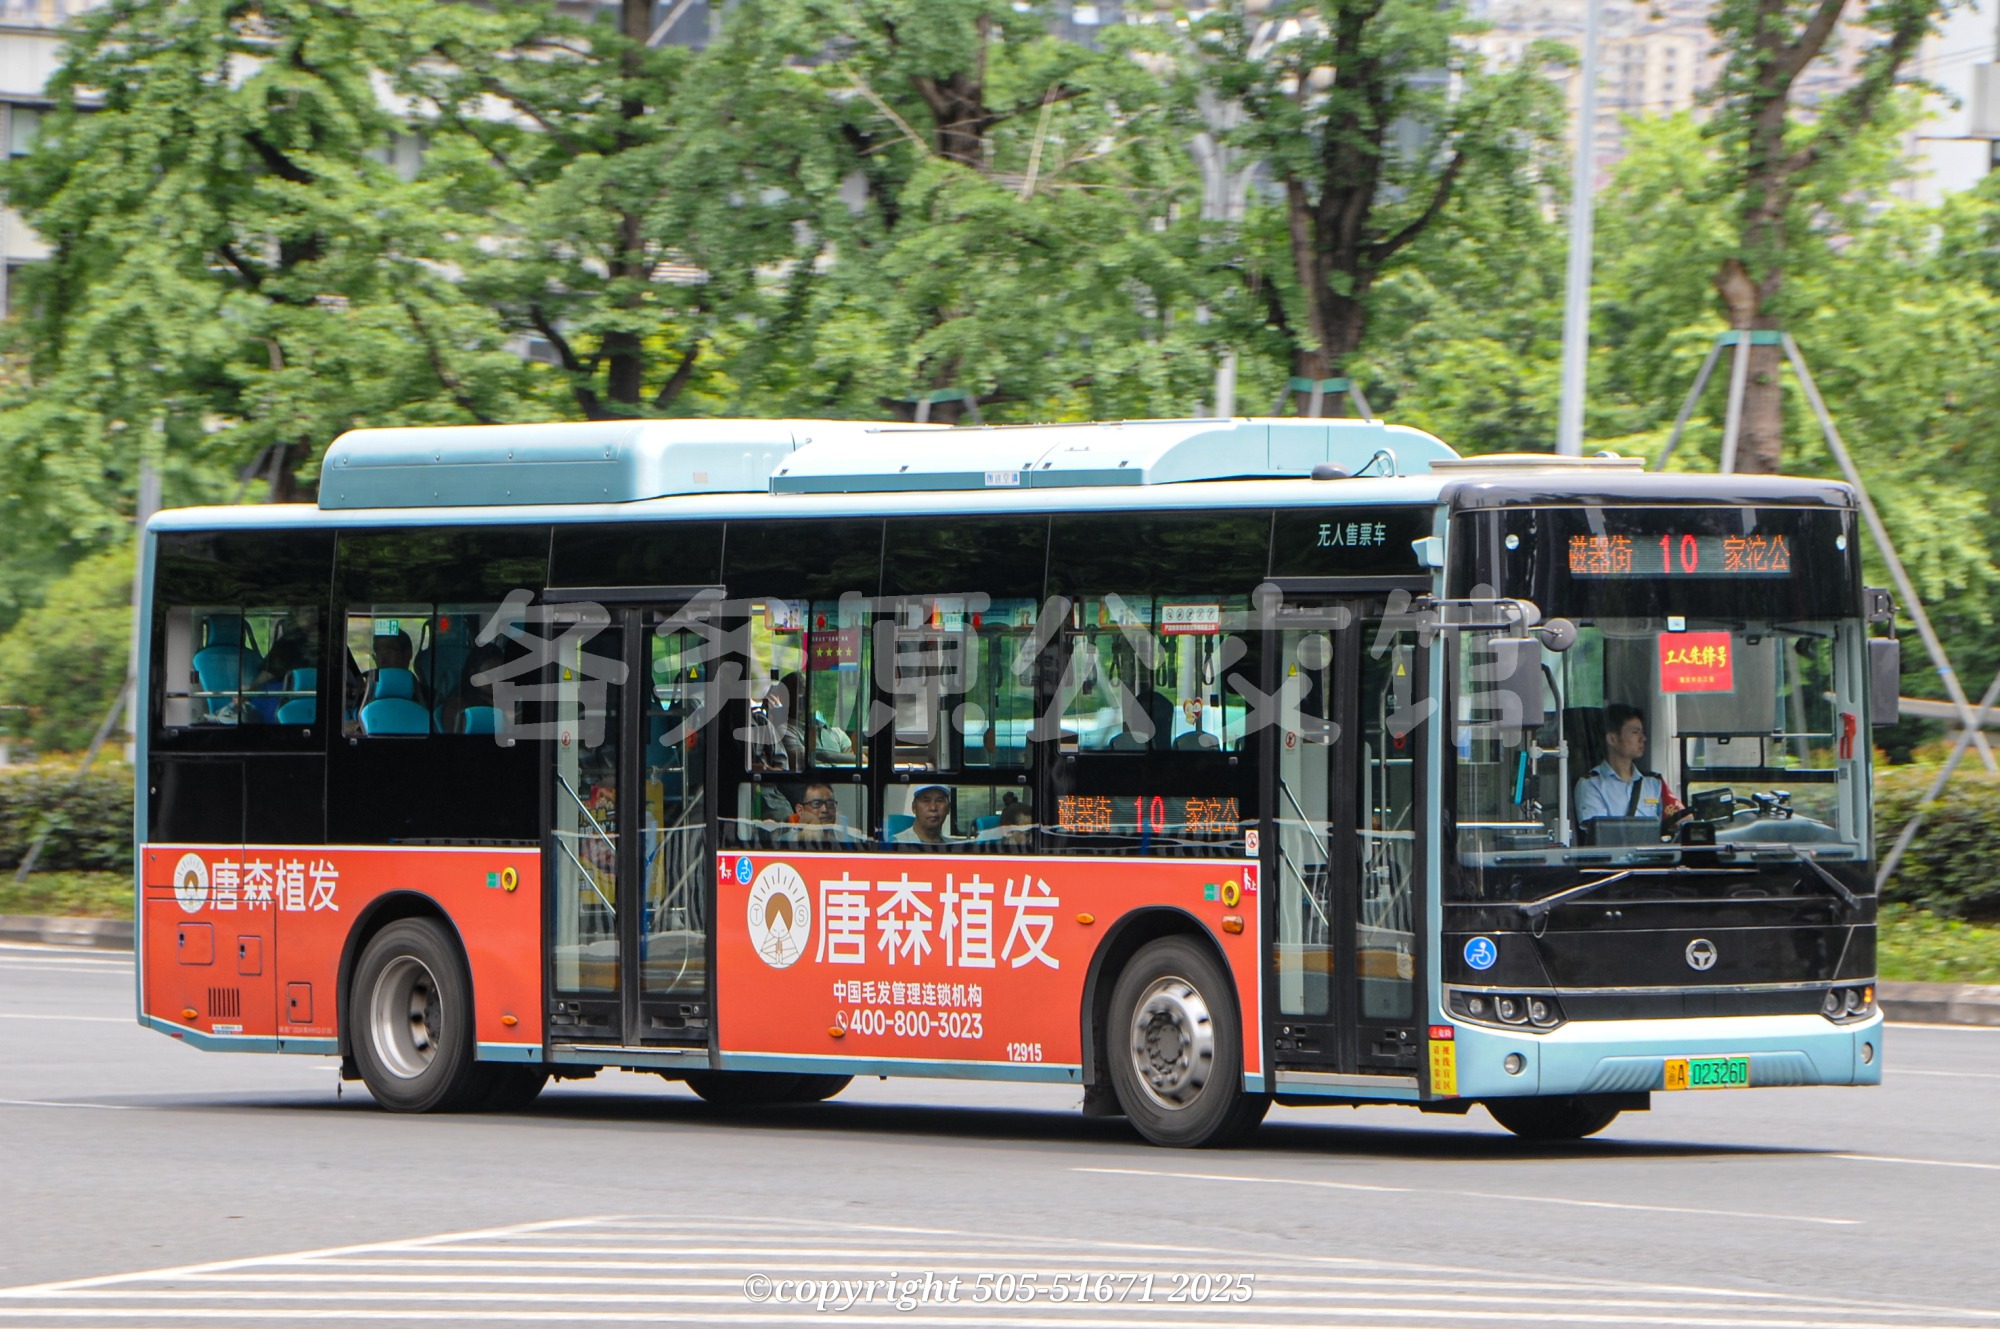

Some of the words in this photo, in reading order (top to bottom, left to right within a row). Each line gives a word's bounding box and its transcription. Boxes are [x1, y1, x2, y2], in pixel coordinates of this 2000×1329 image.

[1317, 522, 1386, 546] 无人售票车
[1659, 534, 1699, 574] 10
[1723, 534, 1791, 573] 家沱公
[1664, 645, 1727, 668] 工人先锋号
[1134, 795, 1165, 834] 10
[208, 857, 340, 913] 唐森植发
[753, 908, 760, 919] T
[798, 909, 805, 923] S
[814, 871, 1060, 970] 唐森植发
[832, 979, 983, 1008] 中国毛发管理连锁机构
[850, 1008, 984, 1039] 400-800-3023
[1006, 1042, 1043, 1062] 12915
